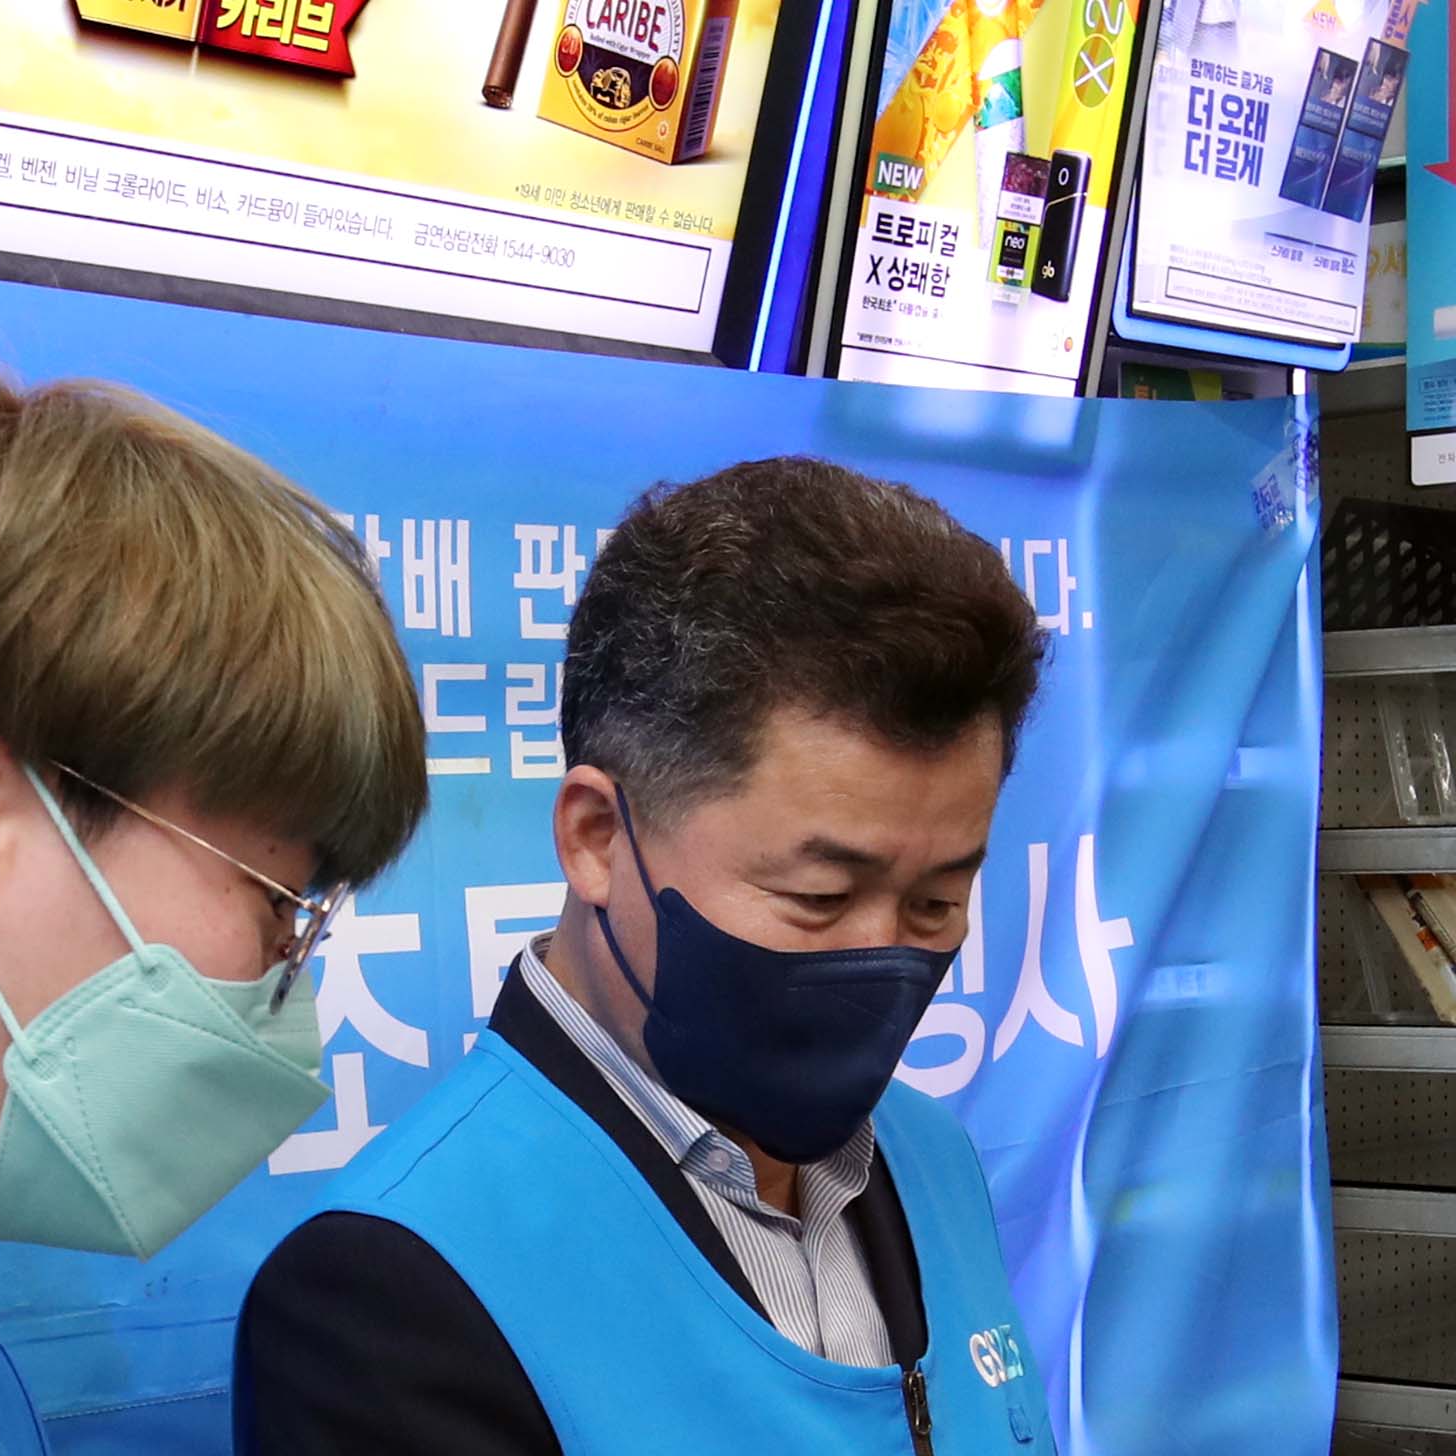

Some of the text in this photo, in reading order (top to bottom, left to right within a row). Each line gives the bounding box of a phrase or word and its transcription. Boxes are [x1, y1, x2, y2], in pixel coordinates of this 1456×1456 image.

[1191, 58, 1238, 87] 함께하는
[1188, 86, 1270, 143] 더 오래
[877, 159, 924, 190] NEW
[1184, 130, 1264, 187] 더 길게
[64, 164, 101, 193] 비닐
[195, 186, 230, 215] 비소,
[236, 192, 300, 225] 카드뮴이
[302, 202, 395, 242] 들어있습니다.
[413, 222, 500, 257] 금연상담전화
[502, 239, 576, 268] 1544-9030
[545, 187, 566, 207] 미만
[569, 190, 621, 217] 청소년에게
[625, 201, 657, 225] 판매할
[658, 209, 672, 226] 수
[872, 212, 959, 258] 트로피컬
[866, 254, 951, 298] X 상쾌함
